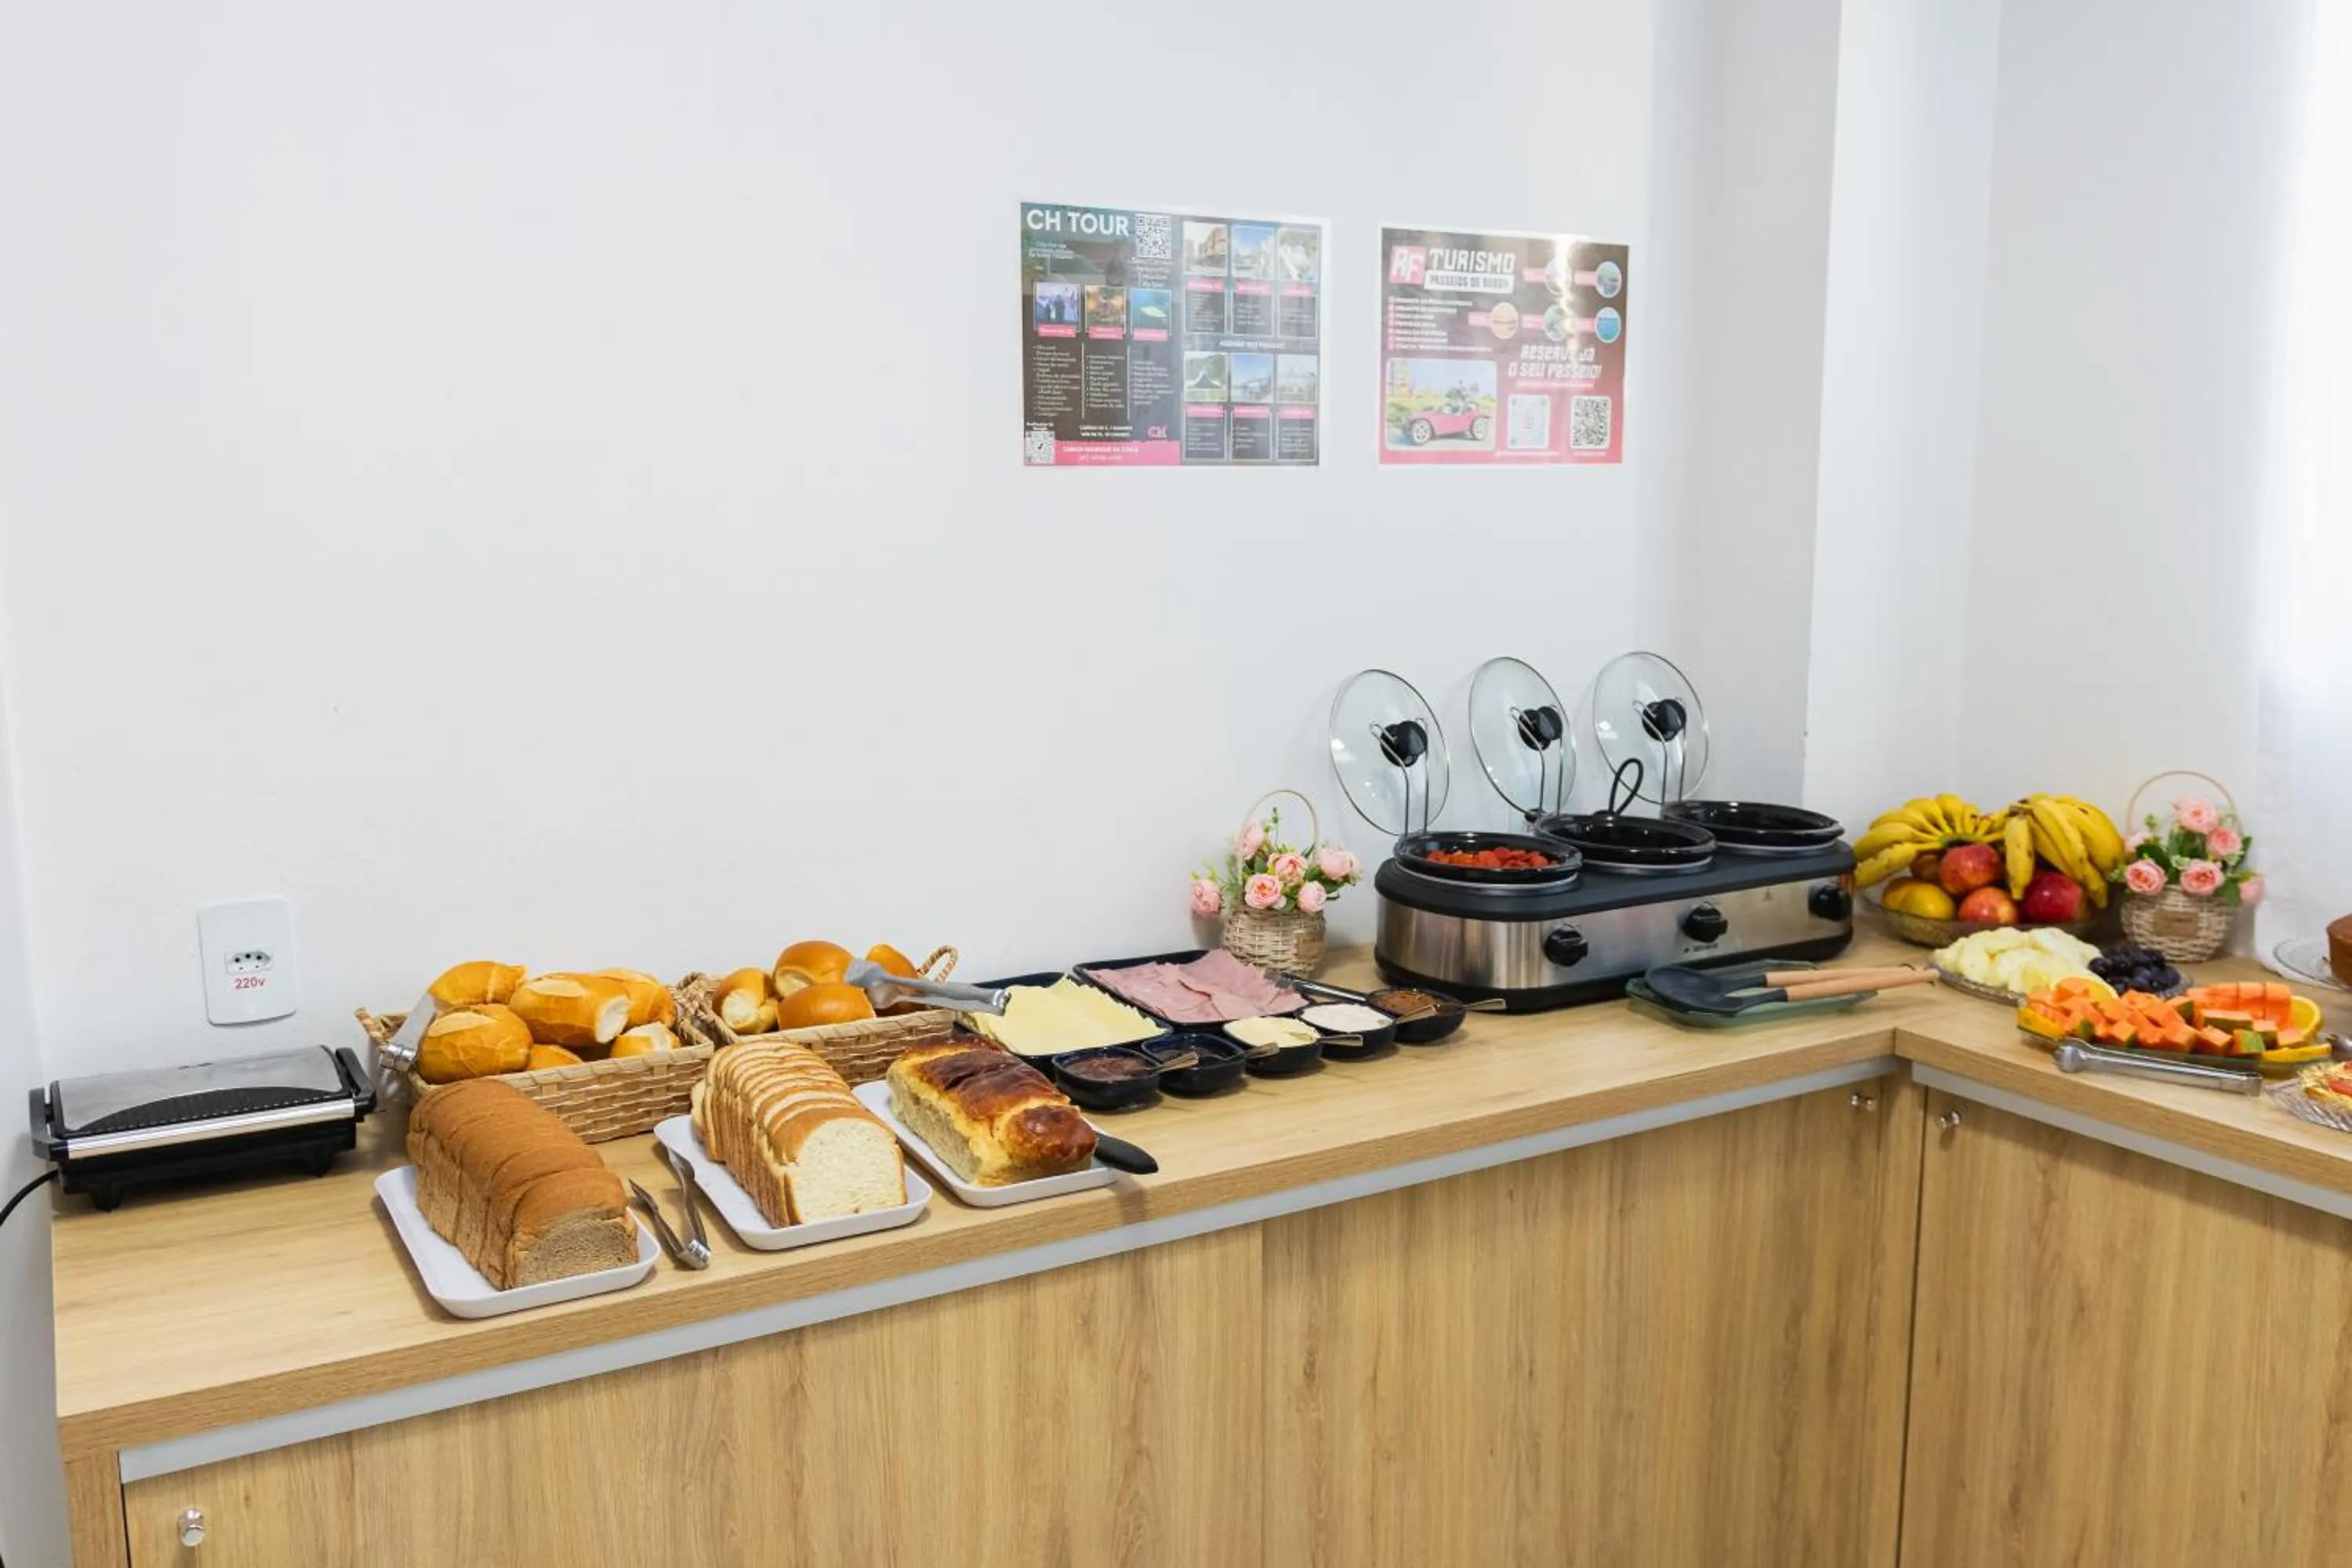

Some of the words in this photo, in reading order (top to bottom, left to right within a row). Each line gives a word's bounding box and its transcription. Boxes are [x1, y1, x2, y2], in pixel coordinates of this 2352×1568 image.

[1026, 209, 1061, 232] CH
[1067, 212, 1129, 237] TOUR
[1429, 248, 1515, 274] TURISMO
